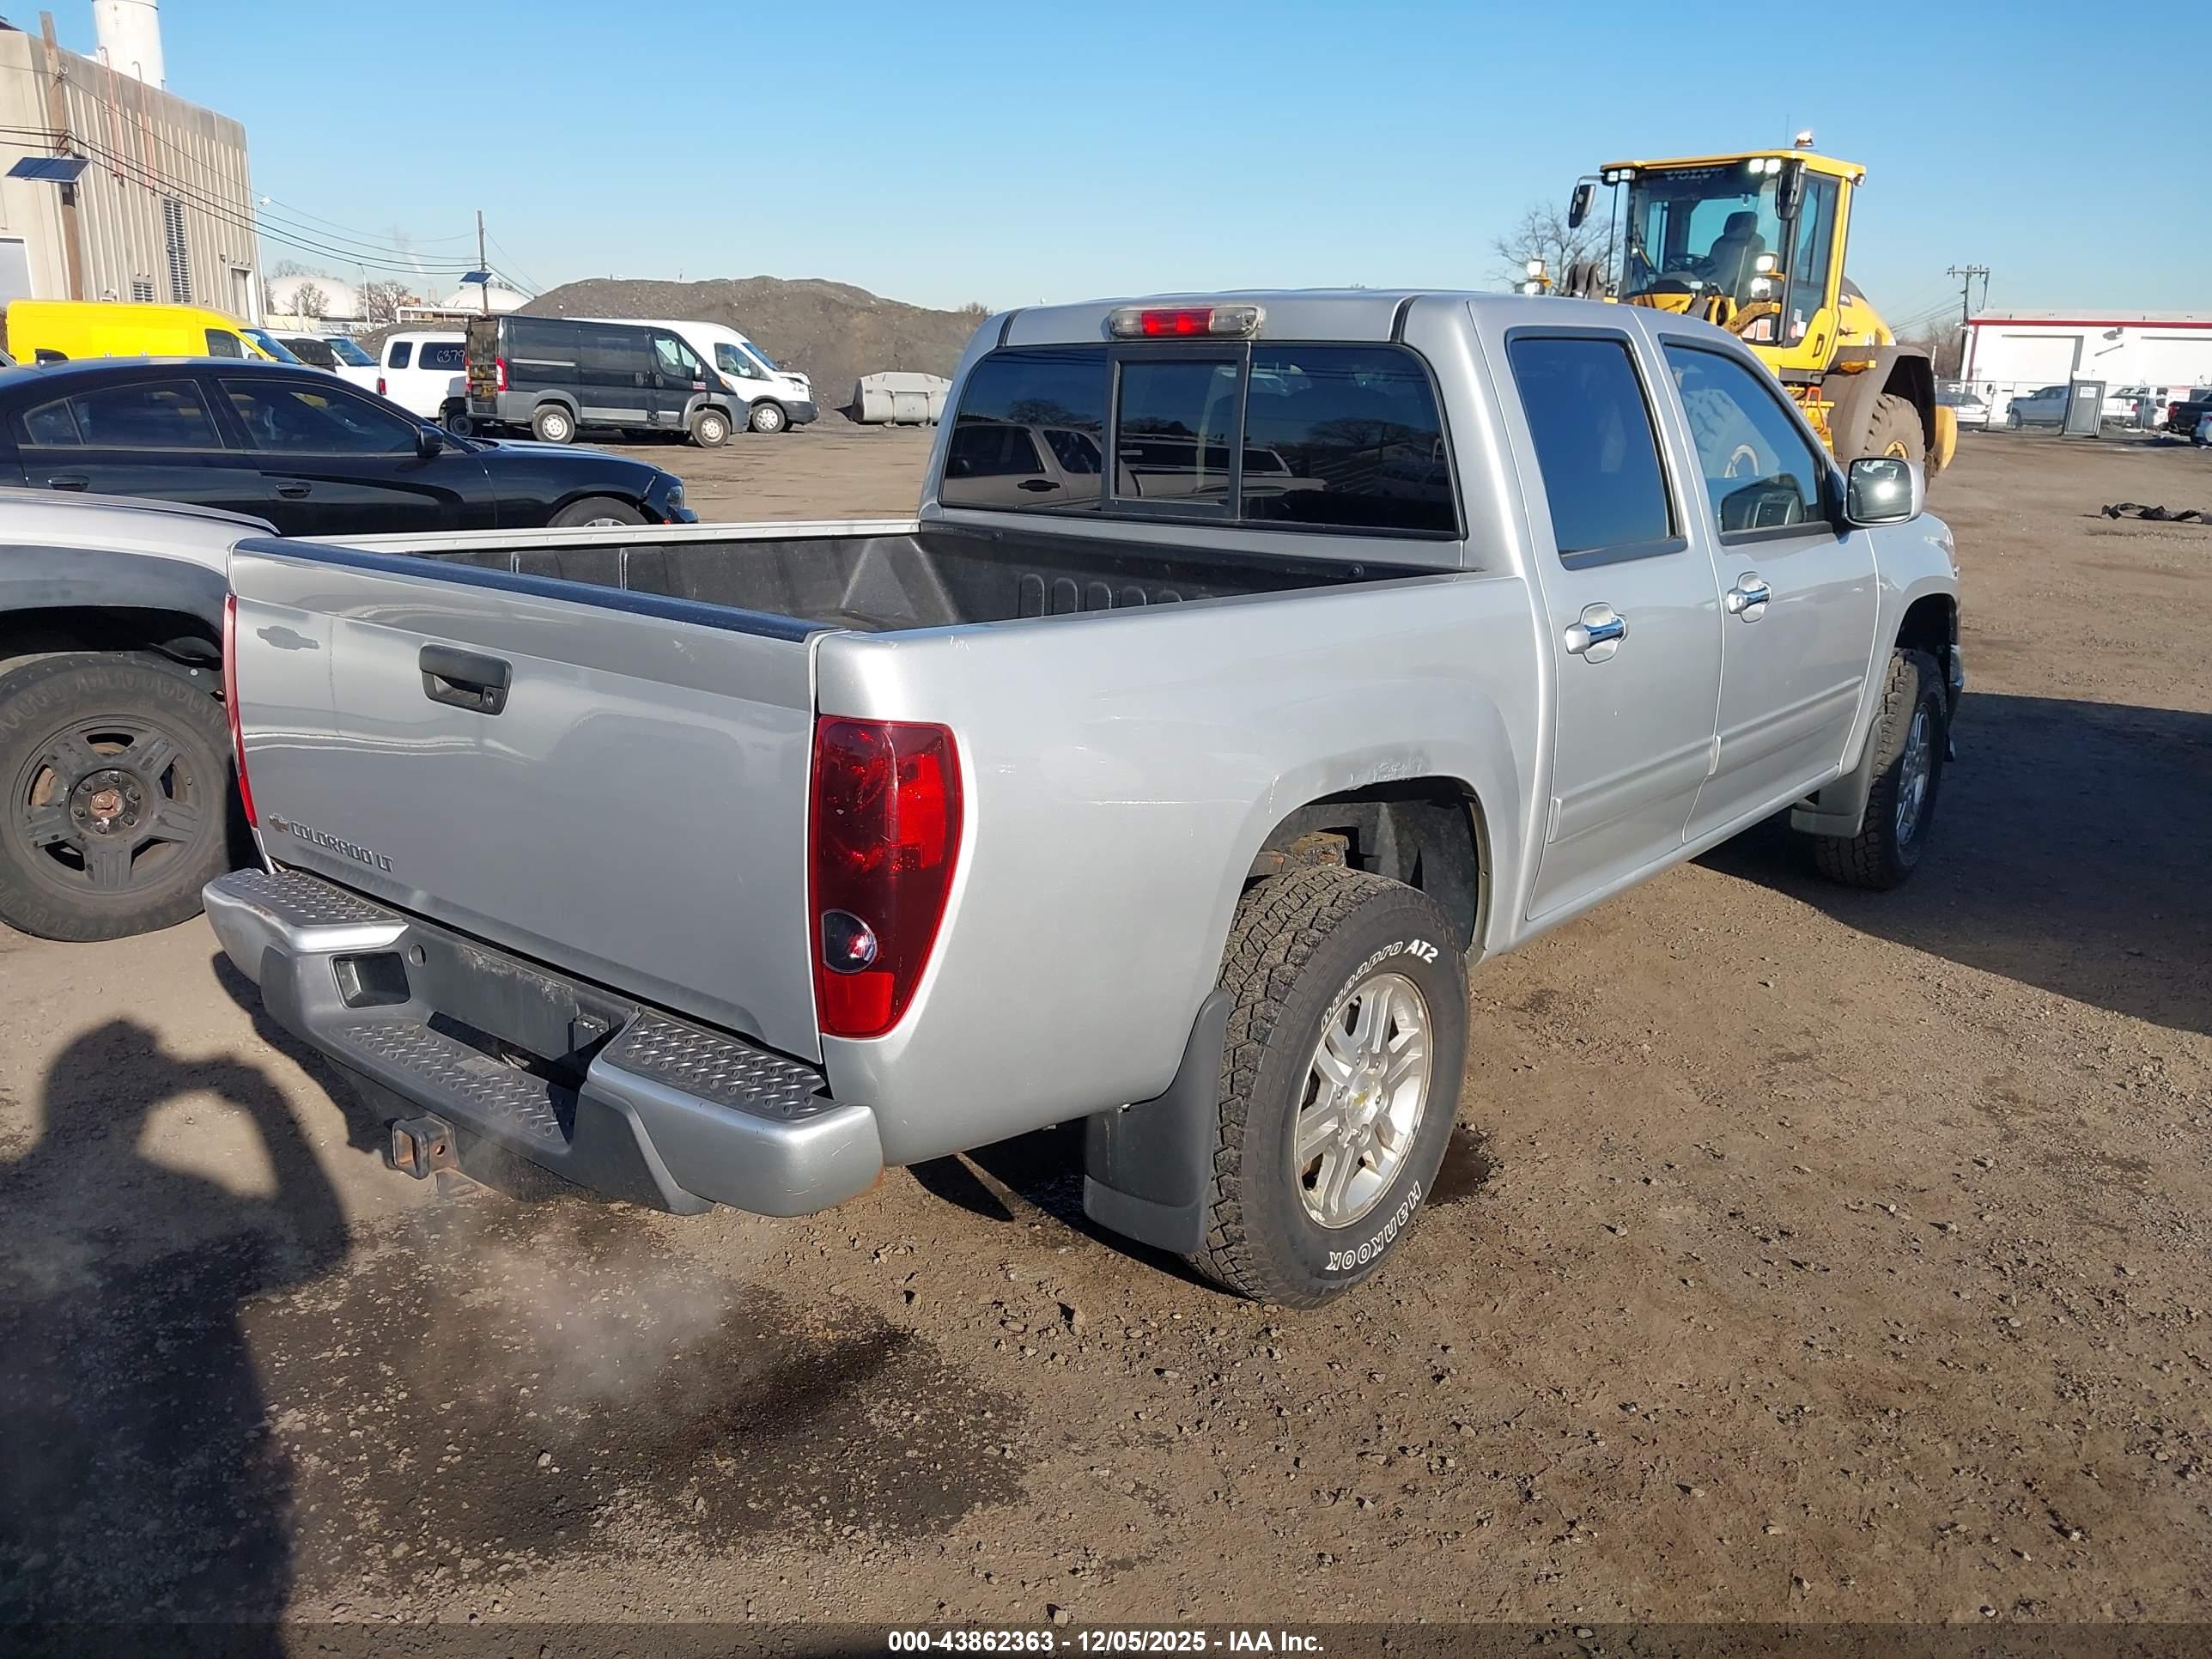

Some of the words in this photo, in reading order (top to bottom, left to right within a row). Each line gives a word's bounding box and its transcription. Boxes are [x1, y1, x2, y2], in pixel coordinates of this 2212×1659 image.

[437, 349, 465, 364] 6379
[291, 822, 374, 865] COLORADO
[377, 854, 394, 872] LT
[1403, 939, 1439, 963] AT2
